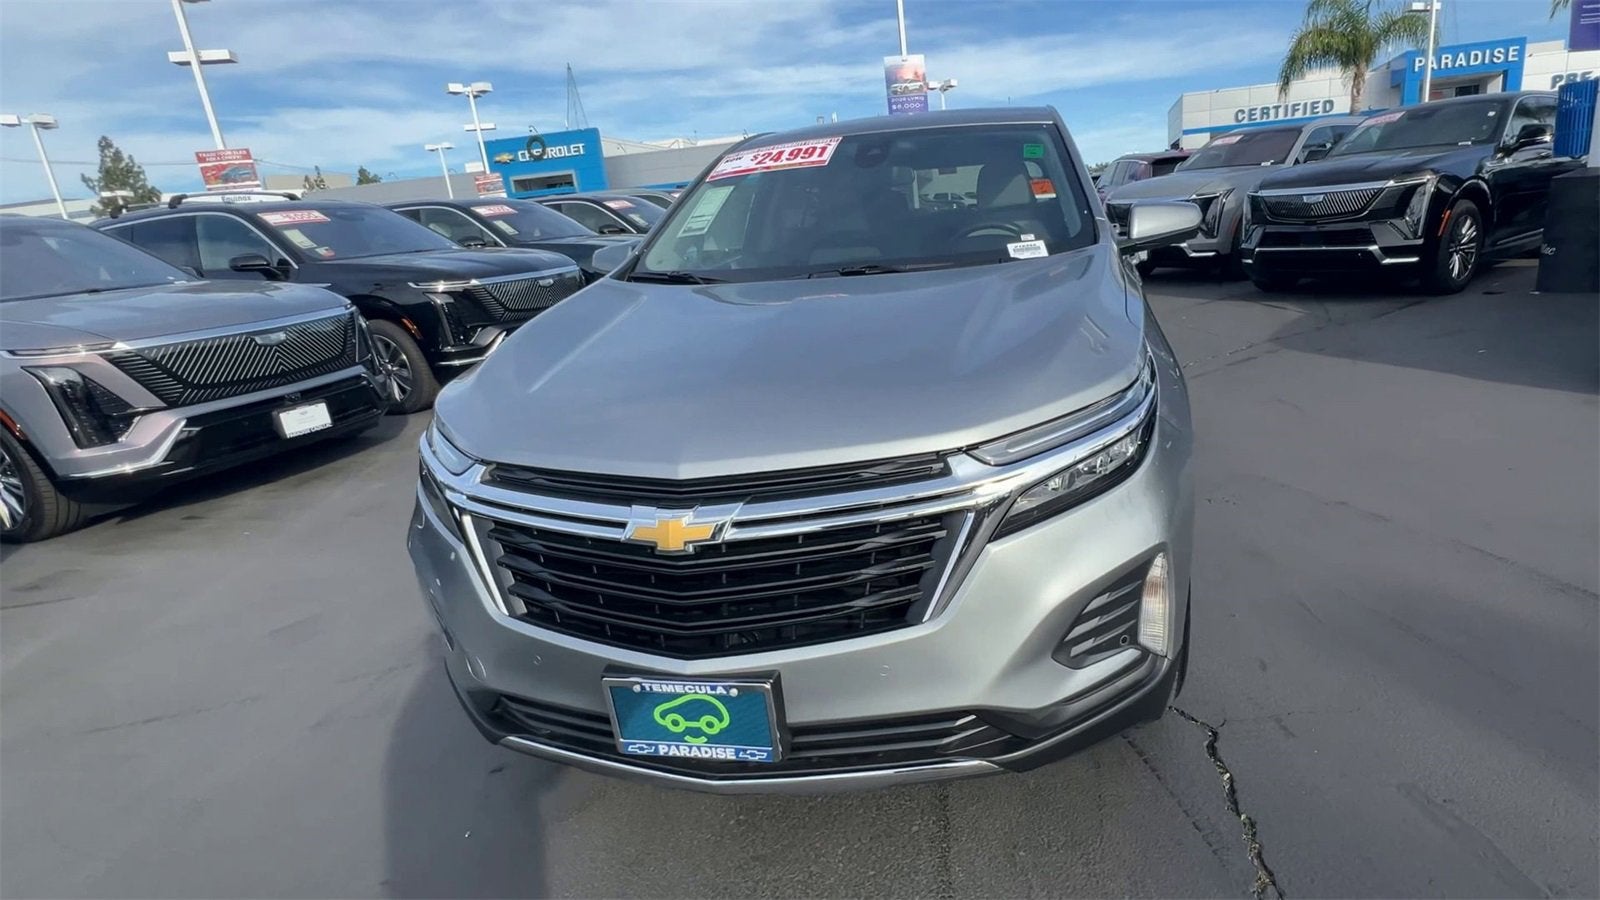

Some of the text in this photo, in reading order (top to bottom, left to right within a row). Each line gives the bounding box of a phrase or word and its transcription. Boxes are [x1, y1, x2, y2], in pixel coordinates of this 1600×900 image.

[1414, 46, 1520, 72] PARADISE
[1234, 99, 1335, 123] CERTIFIED
[641, 682, 728, 695] TEMECULA
[657, 744, 737, 759] PARADISE
